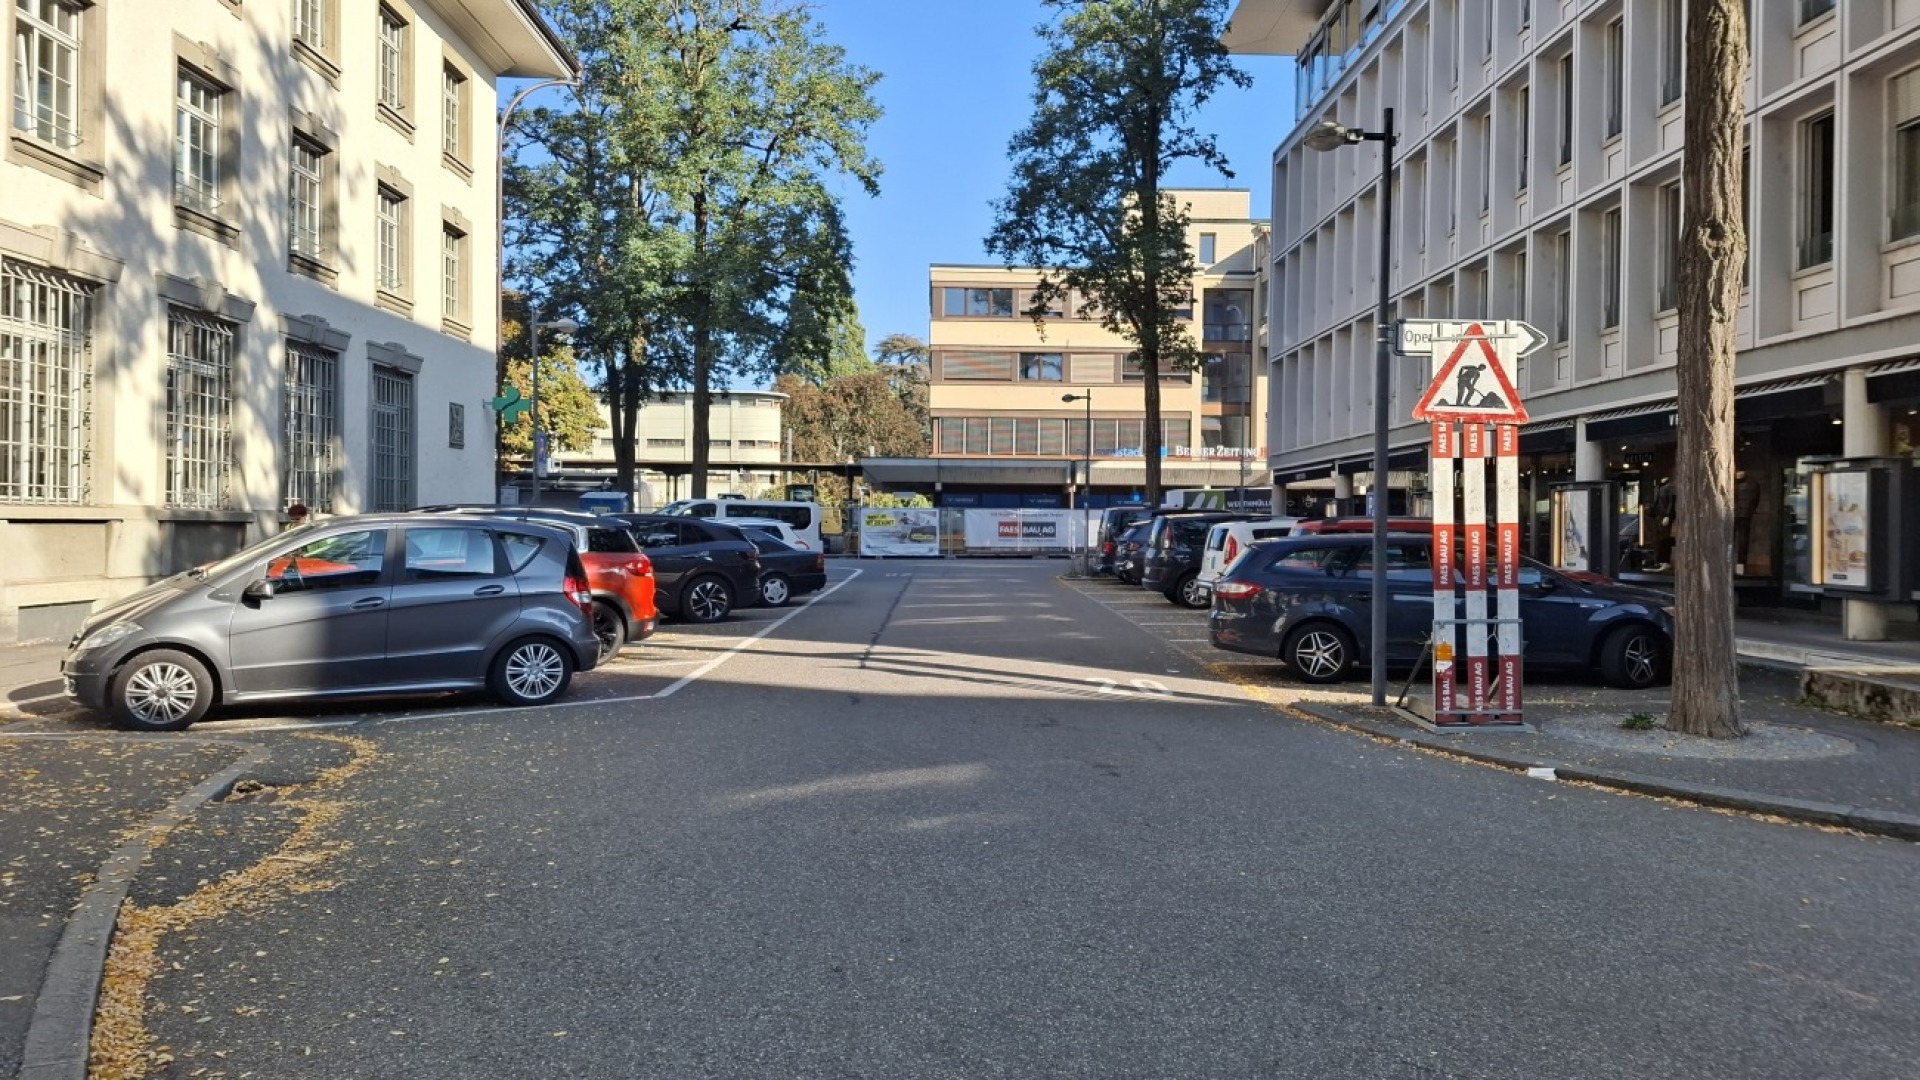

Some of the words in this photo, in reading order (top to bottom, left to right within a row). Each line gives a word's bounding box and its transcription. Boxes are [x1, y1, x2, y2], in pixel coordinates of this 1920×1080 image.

[1438, 432, 1446, 453] FAES
[1503, 431, 1512, 452] FAES
[1440, 530, 1448, 544] AG
[1472, 530, 1480, 544] AG
[1504, 530, 1512, 544] AG
[1440, 545, 1448, 563] BAU
[1472, 546, 1480, 563] BAU
[1504, 545, 1512, 563] BAU
[1440, 564, 1448, 584] FAES
[1472, 565, 1480, 585] FAES
[1504, 564, 1512, 584] FAES
[1474, 662, 1482, 676] AG
[1506, 662, 1513, 675] AG
[1475, 677, 1483, 695] BAU
[1506, 676, 1514, 695] BAU
[1475, 696, 1483, 712] AES
[1506, 695, 1514, 711] AES
